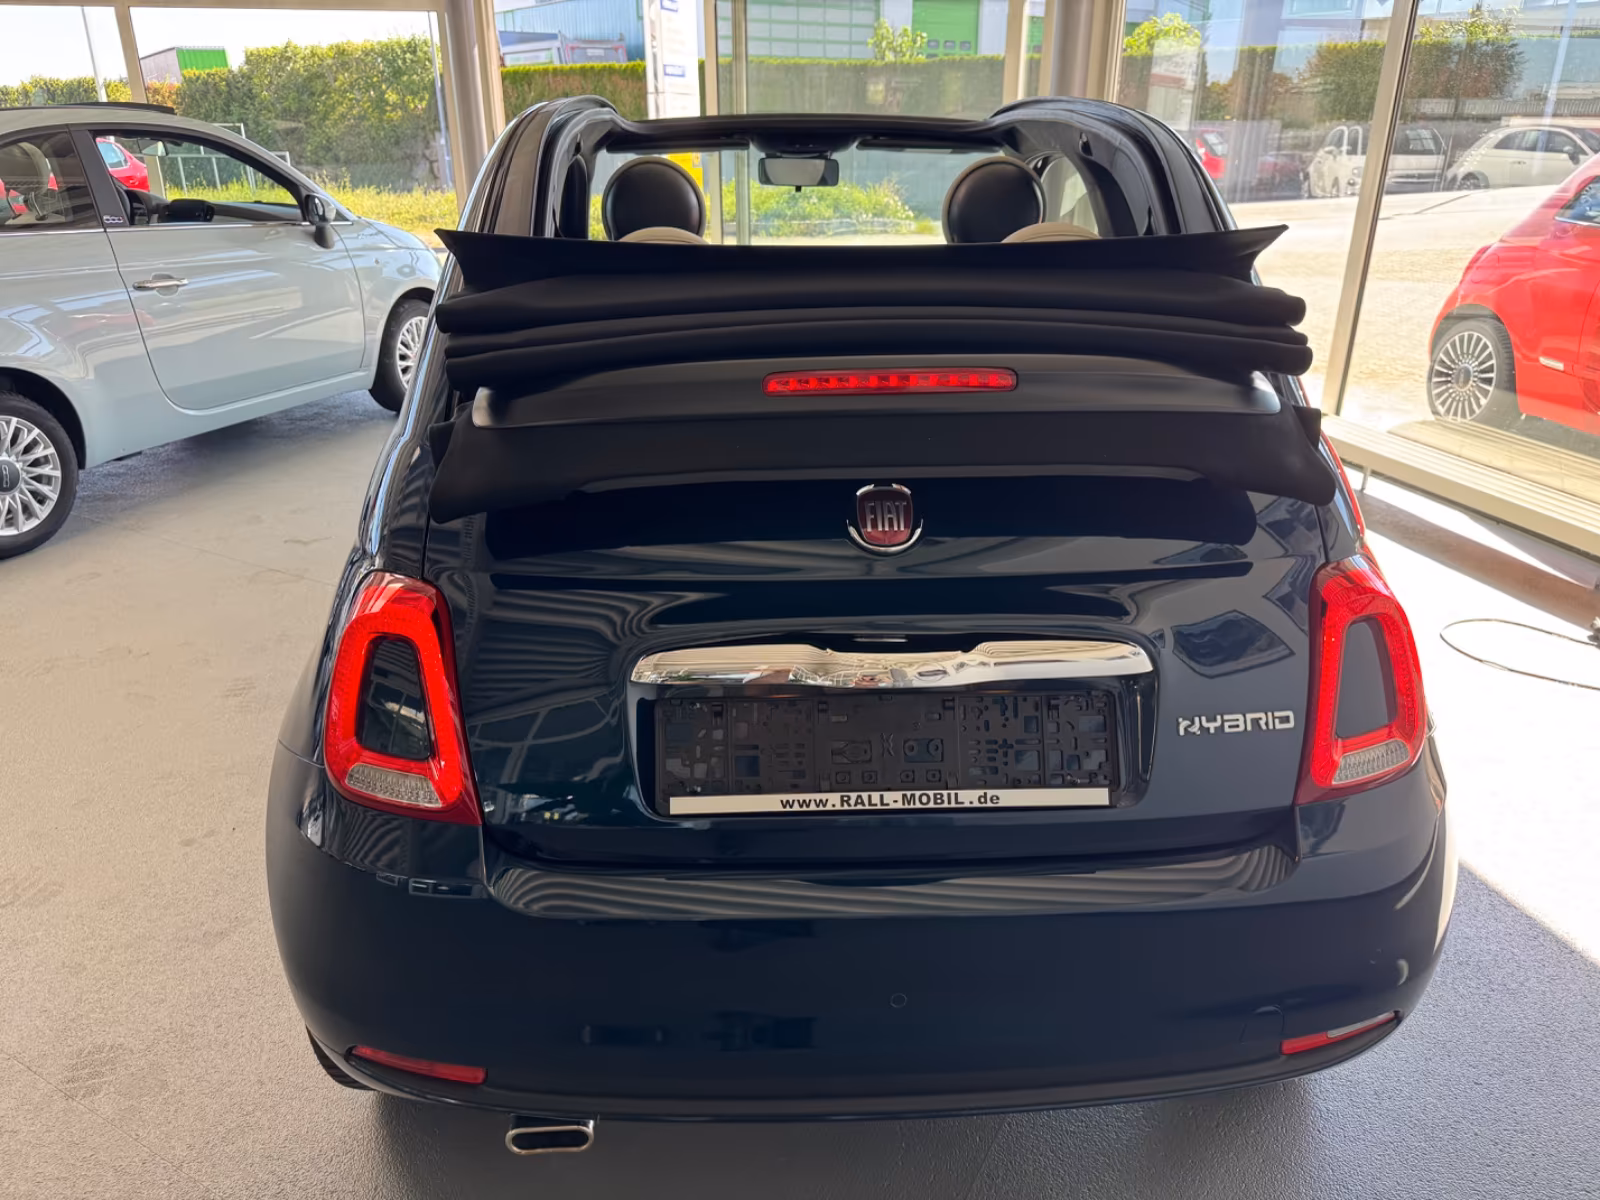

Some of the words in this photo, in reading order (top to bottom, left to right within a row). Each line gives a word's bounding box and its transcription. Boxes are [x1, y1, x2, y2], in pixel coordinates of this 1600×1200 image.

[864, 501, 907, 532] FIAT
[1178, 710, 1294, 736] HYBRID
[780, 792, 1000, 809] www.RALL-MOBIL.de
